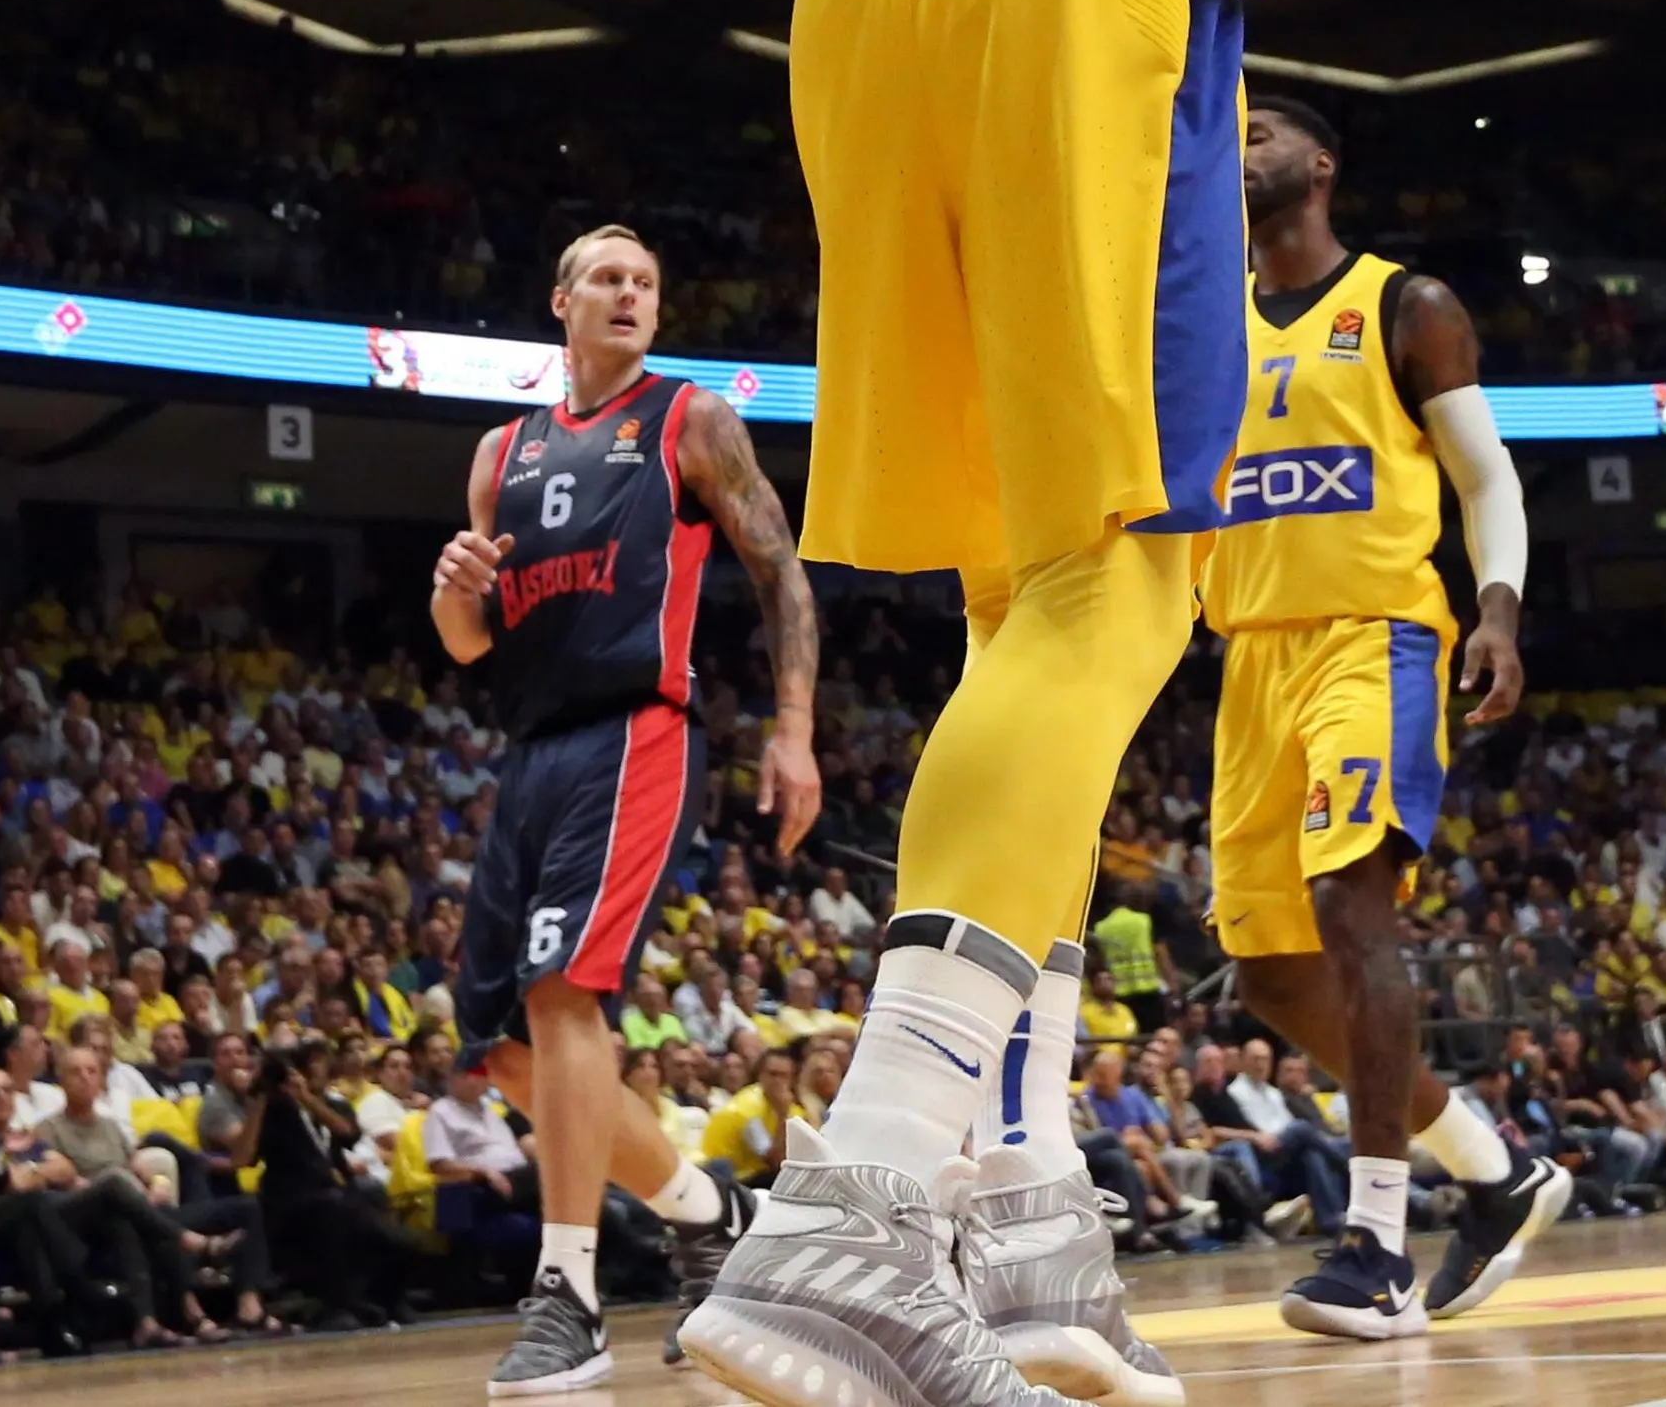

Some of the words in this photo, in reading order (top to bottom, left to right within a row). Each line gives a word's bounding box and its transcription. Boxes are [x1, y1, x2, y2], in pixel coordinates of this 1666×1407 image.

[1261, 355, 1296, 418] 7
[281, 416, 301, 450] 3
[540, 472, 575, 529] 6
[1224, 458, 1357, 514] FOX
[1340, 757, 1382, 824] 7
[527, 907, 567, 965] 6
